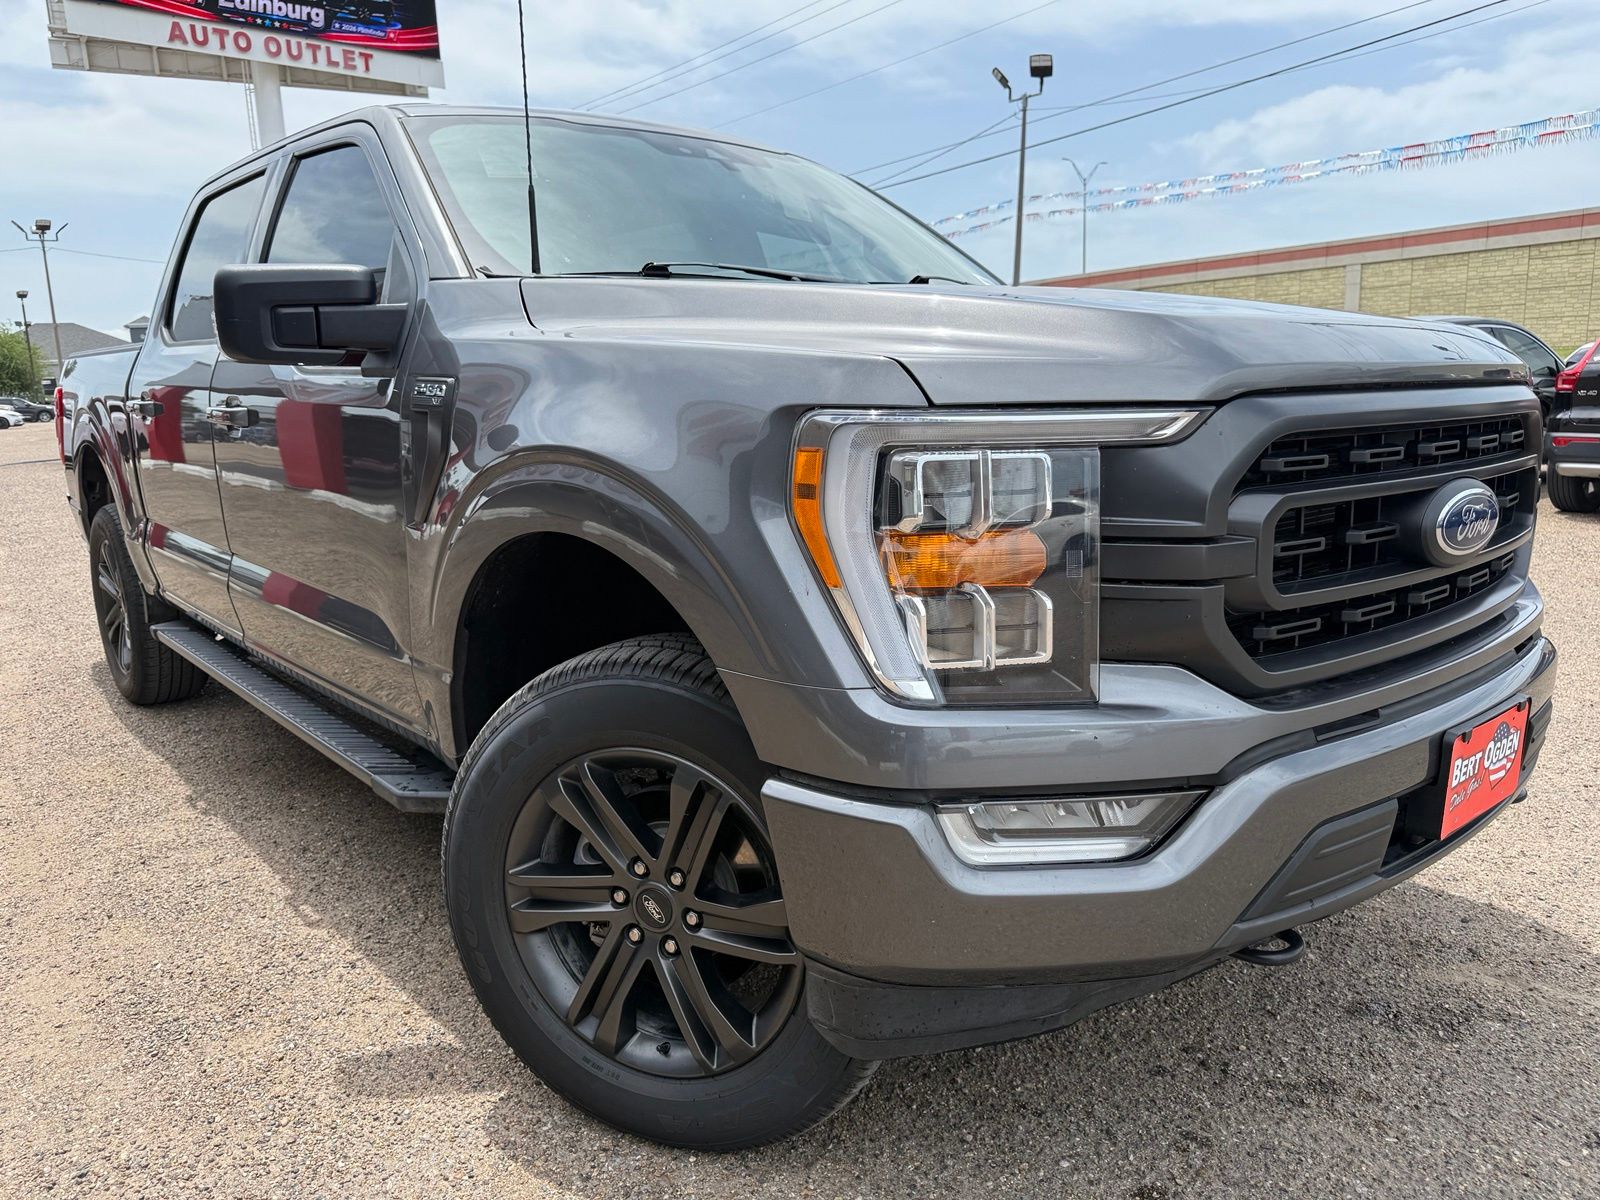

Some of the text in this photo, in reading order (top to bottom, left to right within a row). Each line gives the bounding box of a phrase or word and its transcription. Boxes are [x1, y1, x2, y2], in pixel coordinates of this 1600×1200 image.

[167, 20, 374, 73] AUTO OUTLET
[457, 503, 492, 542] Ford
[1451, 730, 1521, 788] BERT OGDEN
